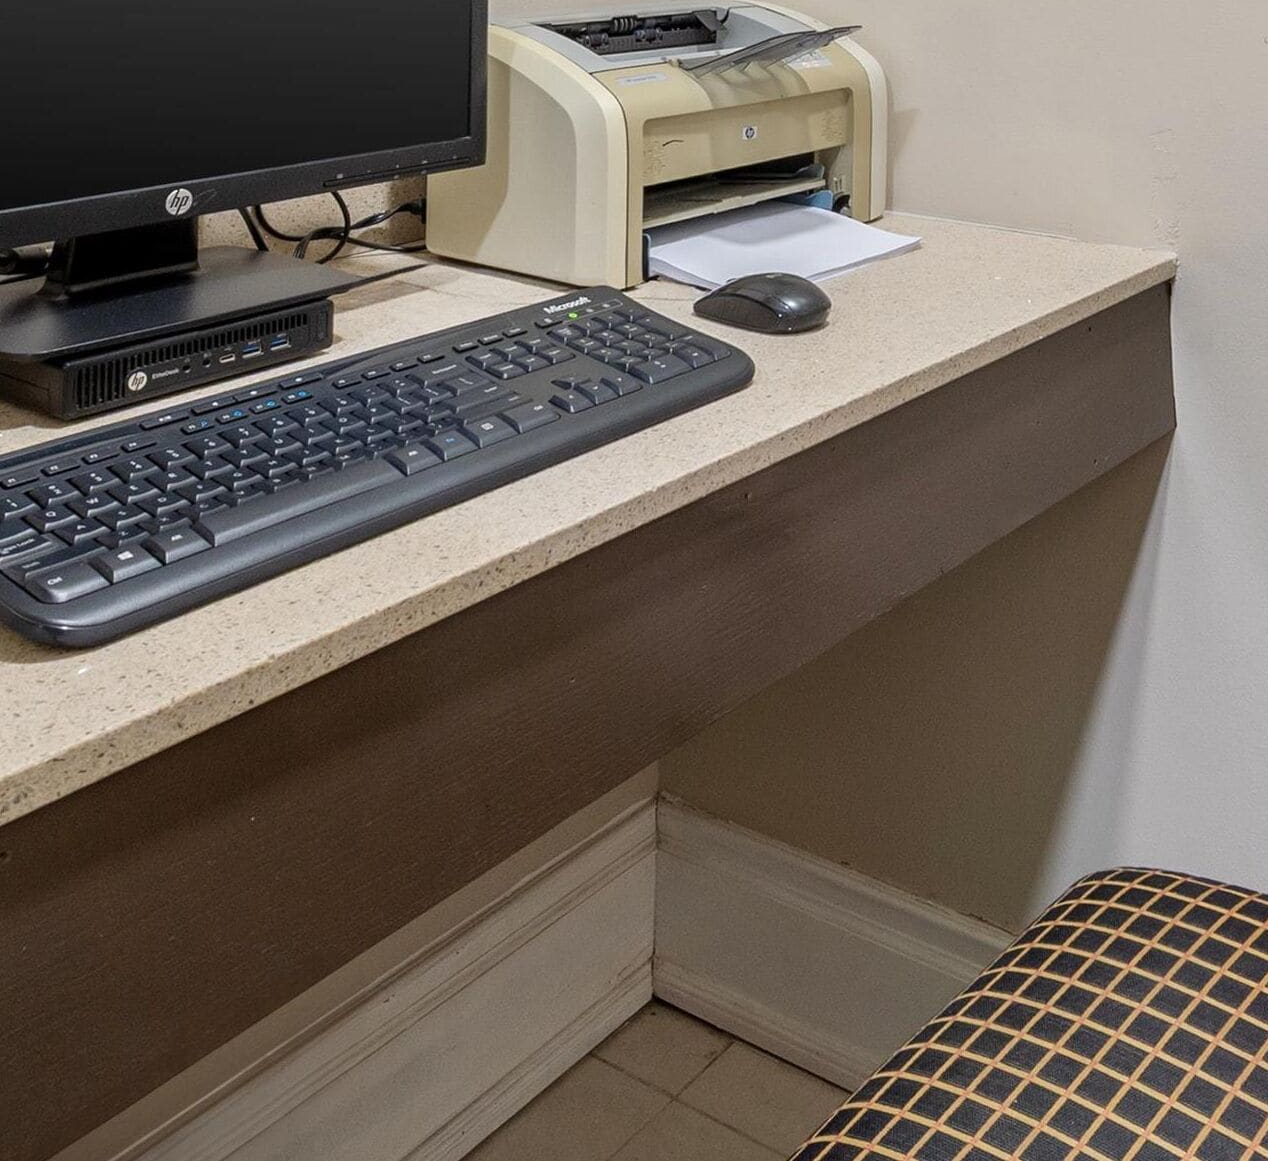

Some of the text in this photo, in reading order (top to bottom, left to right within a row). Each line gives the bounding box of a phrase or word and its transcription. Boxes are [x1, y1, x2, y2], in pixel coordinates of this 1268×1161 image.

[167, 188, 192, 217] hp
[543, 296, 591, 314] Microsoft
[129, 372, 147, 391] hp
